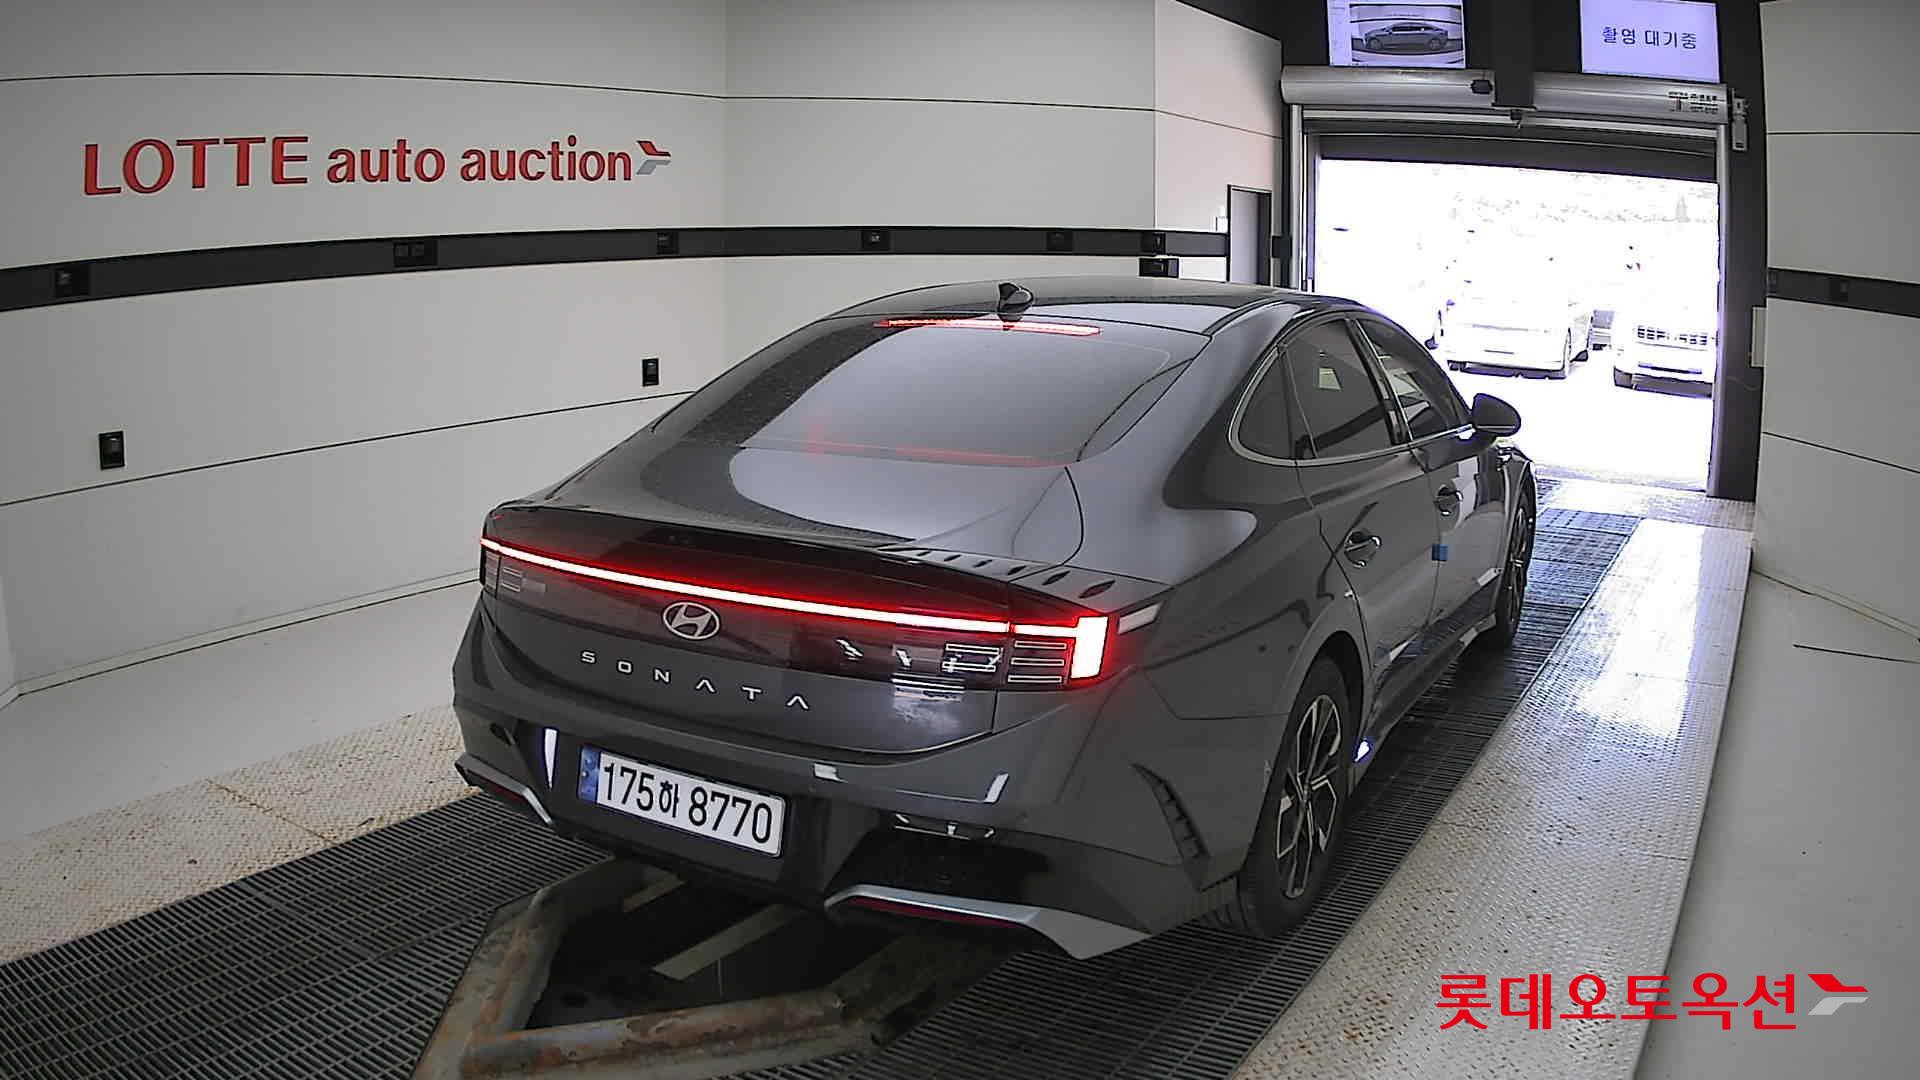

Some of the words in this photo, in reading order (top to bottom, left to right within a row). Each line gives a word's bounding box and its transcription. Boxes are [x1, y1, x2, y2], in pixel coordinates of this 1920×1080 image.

[1644, 29, 1697, 50] 대기중
[83, 135, 309, 196] LOTTE
[327, 138, 446, 185] auto
[460, 134, 633, 182] auction
[581, 650, 809, 711] SONATA
[603, 762, 680, 819] 175하
[688, 786, 773, 844] 8770
